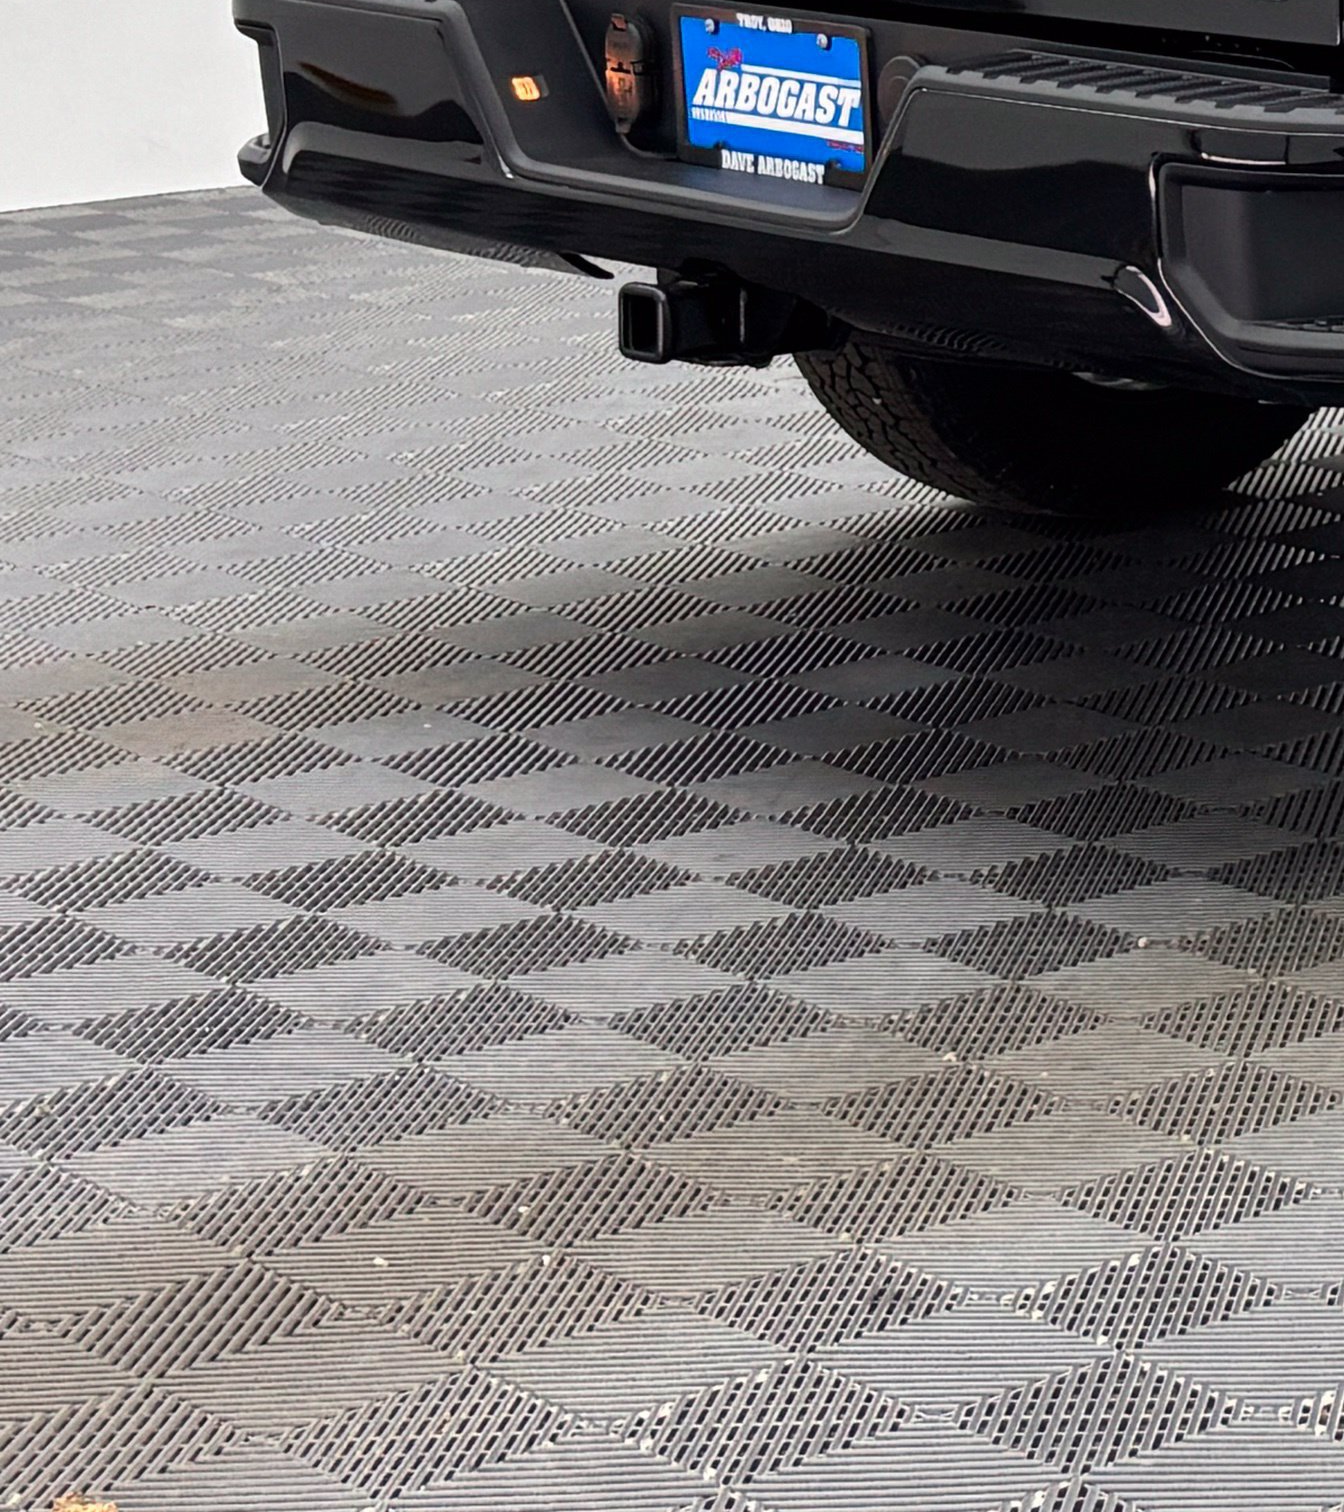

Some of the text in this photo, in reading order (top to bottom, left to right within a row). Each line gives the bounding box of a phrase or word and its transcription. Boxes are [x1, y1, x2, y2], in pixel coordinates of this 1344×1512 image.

[691, 67, 862, 127] ARBOGAST
[720, 148, 826, 185] DAVE ARBOGAST
